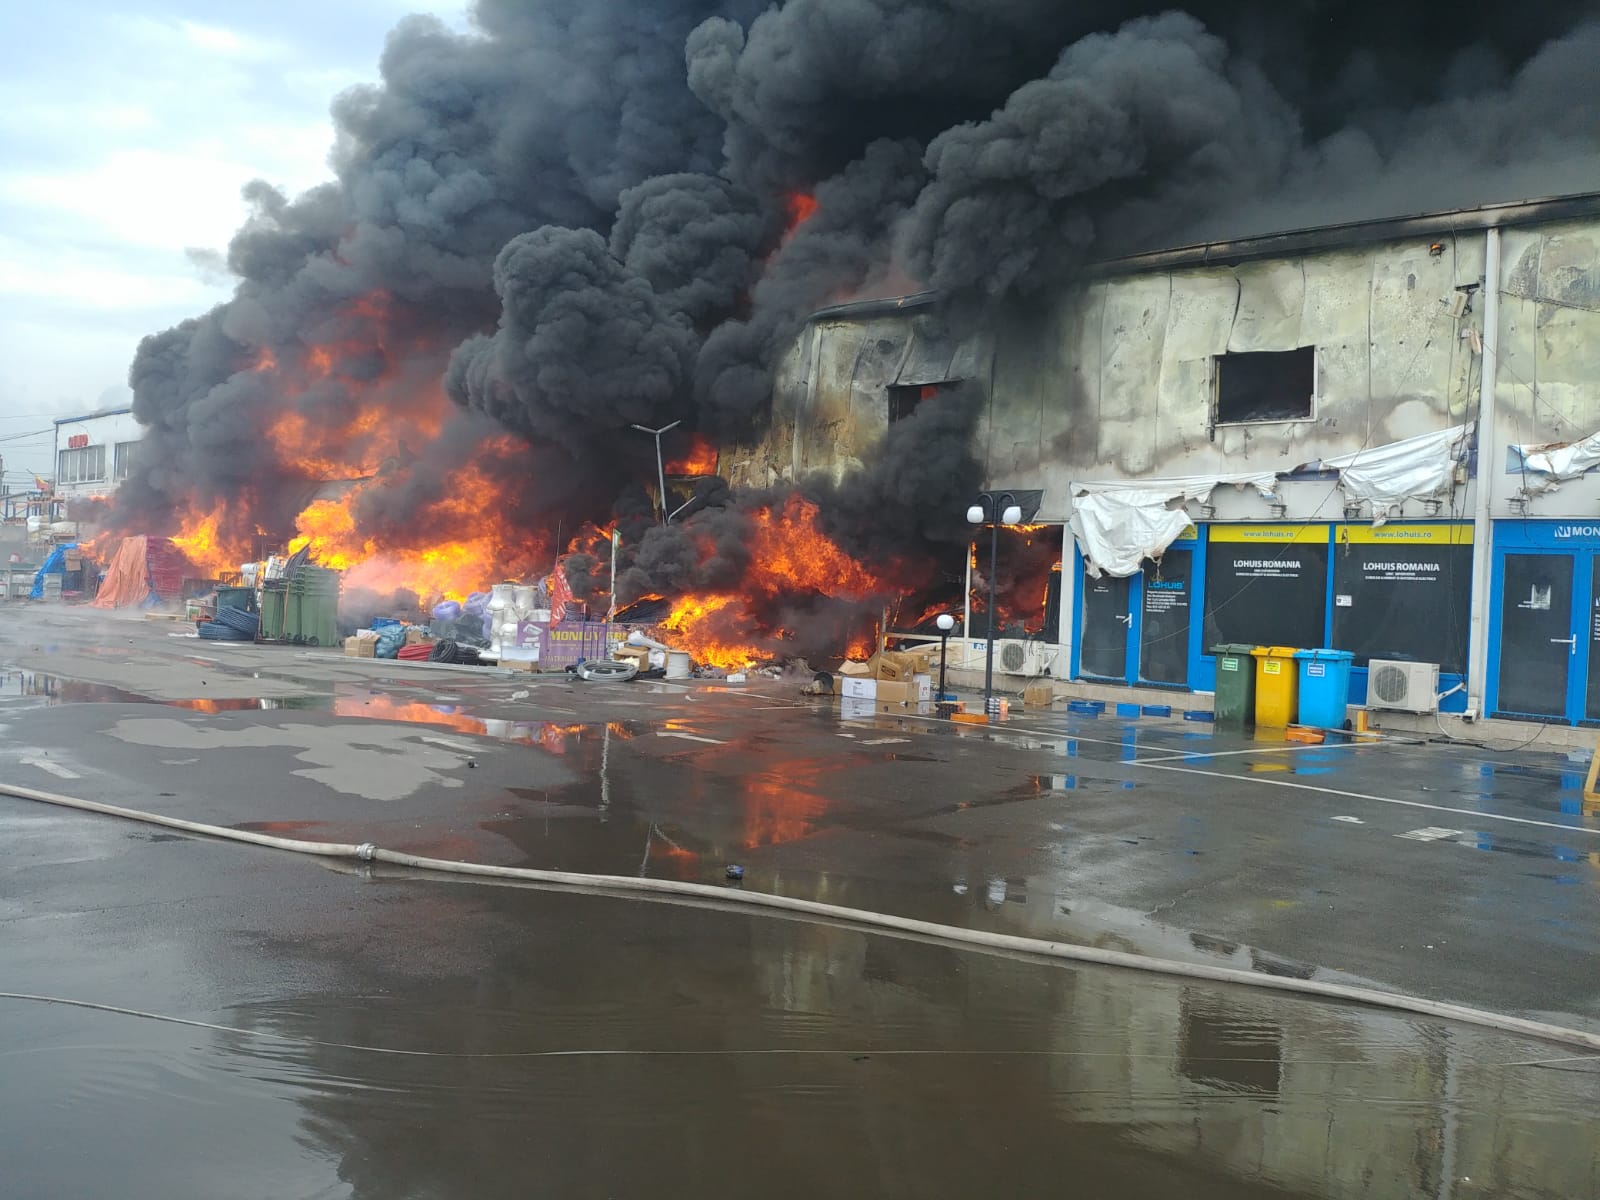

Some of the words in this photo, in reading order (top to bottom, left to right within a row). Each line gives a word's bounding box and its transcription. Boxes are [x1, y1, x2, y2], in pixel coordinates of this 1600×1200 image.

[1374, 530, 1432, 538] www.lohuis.ro
[1233, 560, 1262, 568] LOHUIS
[1263, 560, 1302, 569] ROMANIA
[1363, 562, 1395, 571] LOHUIS
[1396, 562, 1440, 571] ROMANIA
[1148, 581, 1184, 589] LOHUIS
